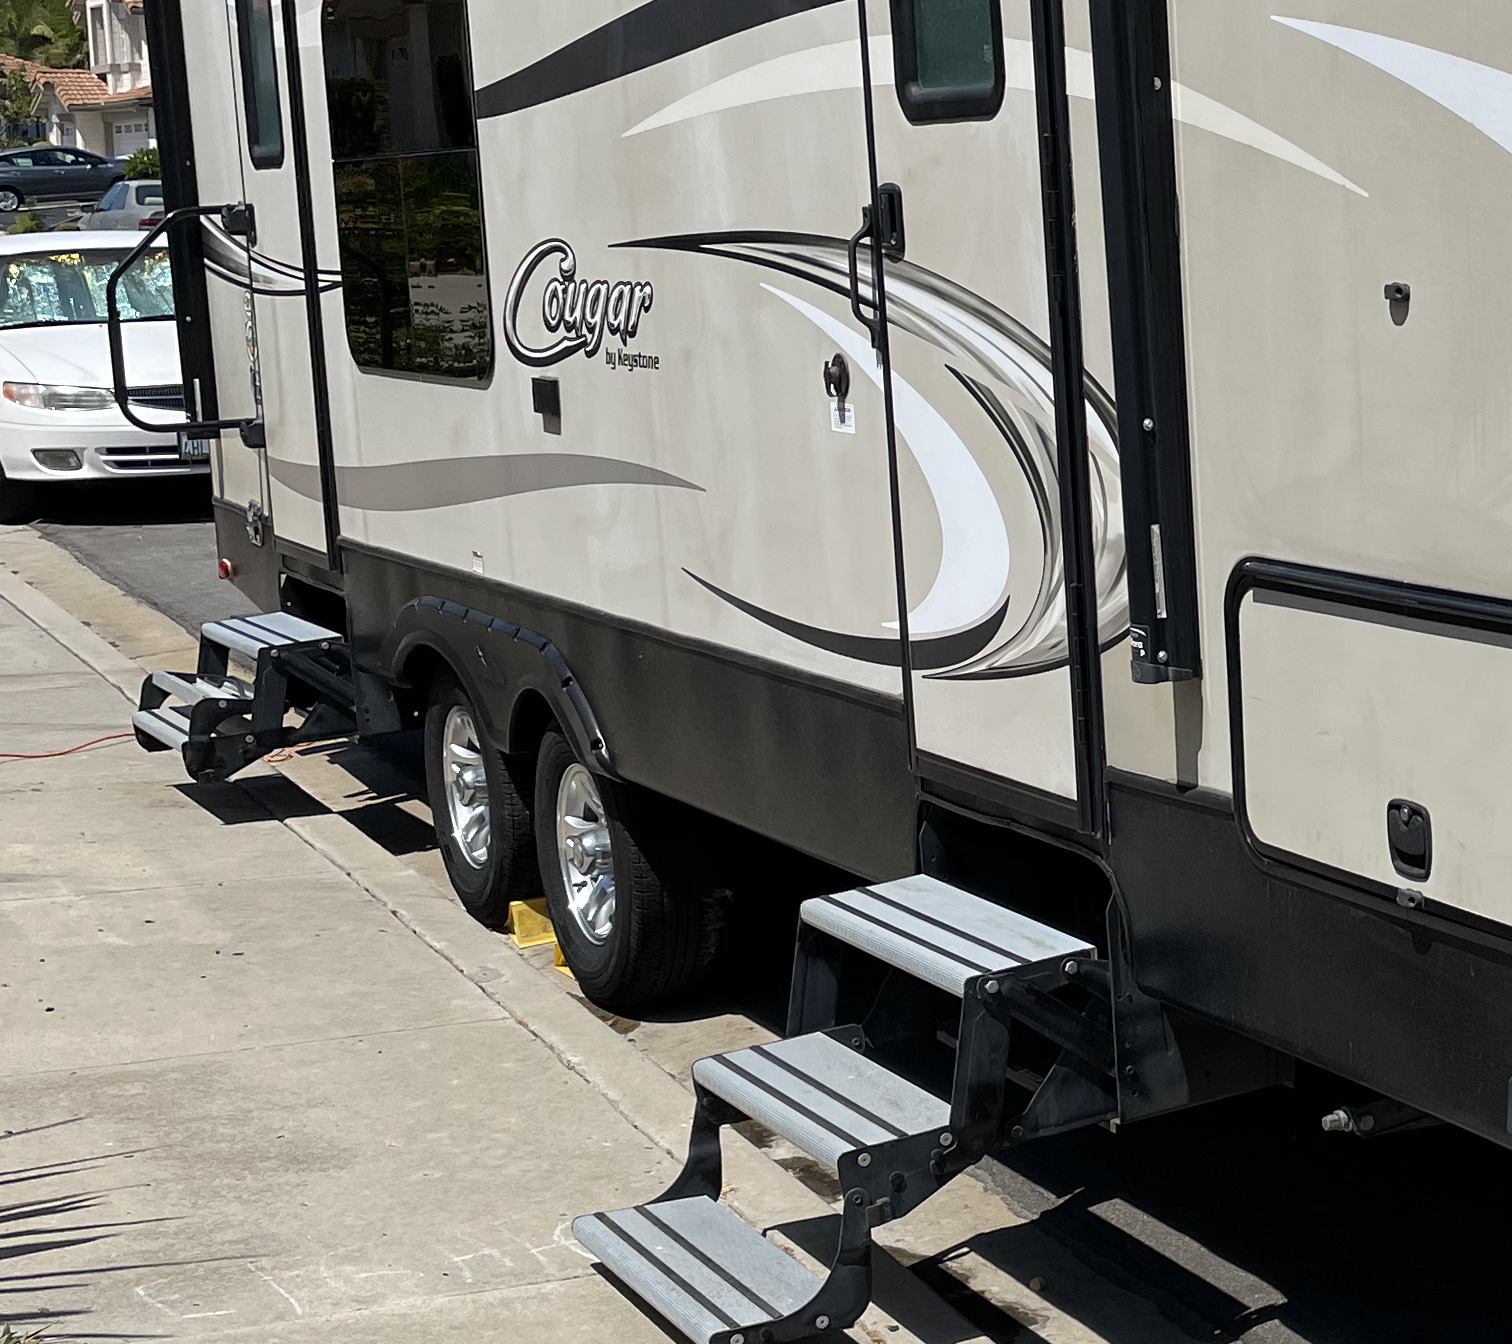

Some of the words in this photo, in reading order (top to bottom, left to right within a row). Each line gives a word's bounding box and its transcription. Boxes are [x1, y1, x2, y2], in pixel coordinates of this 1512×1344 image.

[503, 237, 654, 367] Cougar
[605, 347, 616, 370] by
[617, 347, 660, 371] Keystone
